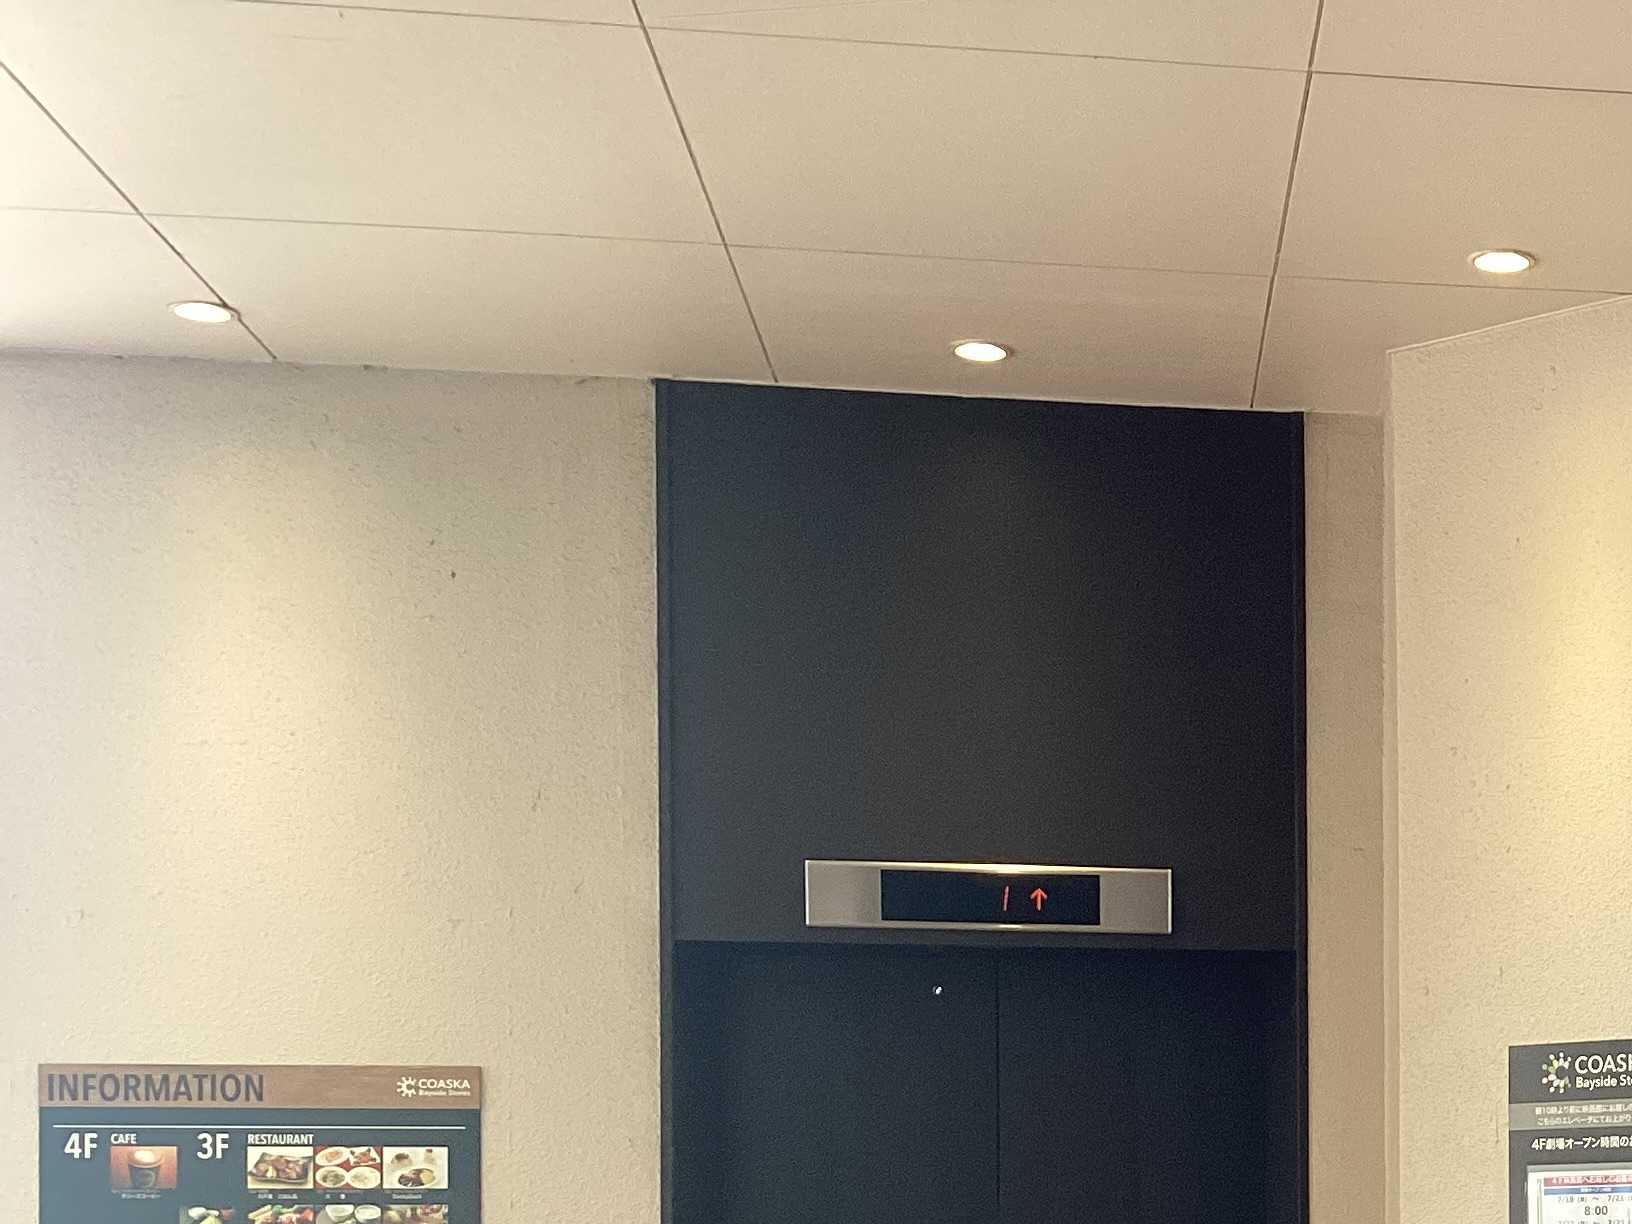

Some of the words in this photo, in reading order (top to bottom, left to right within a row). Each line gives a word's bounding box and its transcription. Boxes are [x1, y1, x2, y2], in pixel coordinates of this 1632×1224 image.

[47, 1073, 265, 1103] INFORMATION
[418, 1078, 471, 1089] COASKA
[1576, 1075, 1617, 1090] Bayside
[110, 1134, 137, 1145] CAFE
[247, 1134, 314, 1145] RESTAURANT
[64, 1133, 98, 1160] 4F
[197, 1133, 230, 1160] 3F
[1584, 1206, 1608, 1216] 8:00
